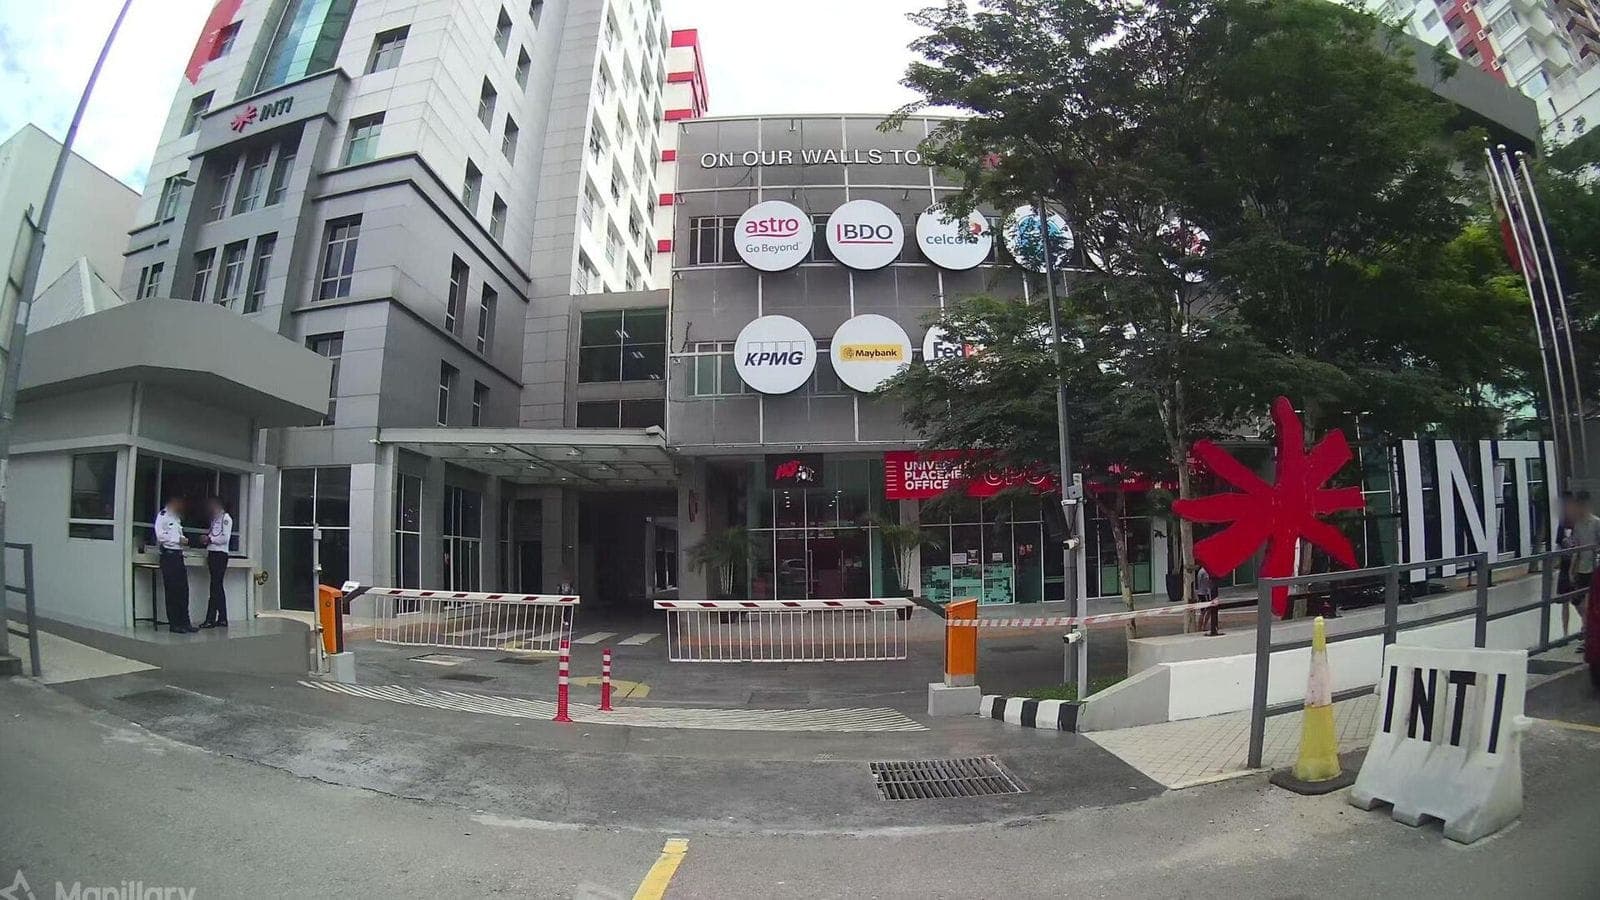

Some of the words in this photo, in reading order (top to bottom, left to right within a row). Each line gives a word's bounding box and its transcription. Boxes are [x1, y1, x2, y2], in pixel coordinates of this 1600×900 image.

[259, 96, 294, 121] INTI
[701, 152, 734, 168] ON
[742, 150, 793, 166] OUR
[802, 149, 883, 165] WALLS
[745, 217, 799, 233] astro
[844, 224, 893, 240] BDO
[926, 234, 978, 245] celco
[745, 244, 760, 253] Go
[761, 242, 799, 254] Beyond
[744, 351, 804, 366] KPMG
[855, 349, 897, 358] Maybank
[905, 470, 970, 481] PLACEME
[905, 480, 950, 490] OFFICE
[1402, 439, 1560, 582] INTI
[1383, 666, 1507, 753] INTI
